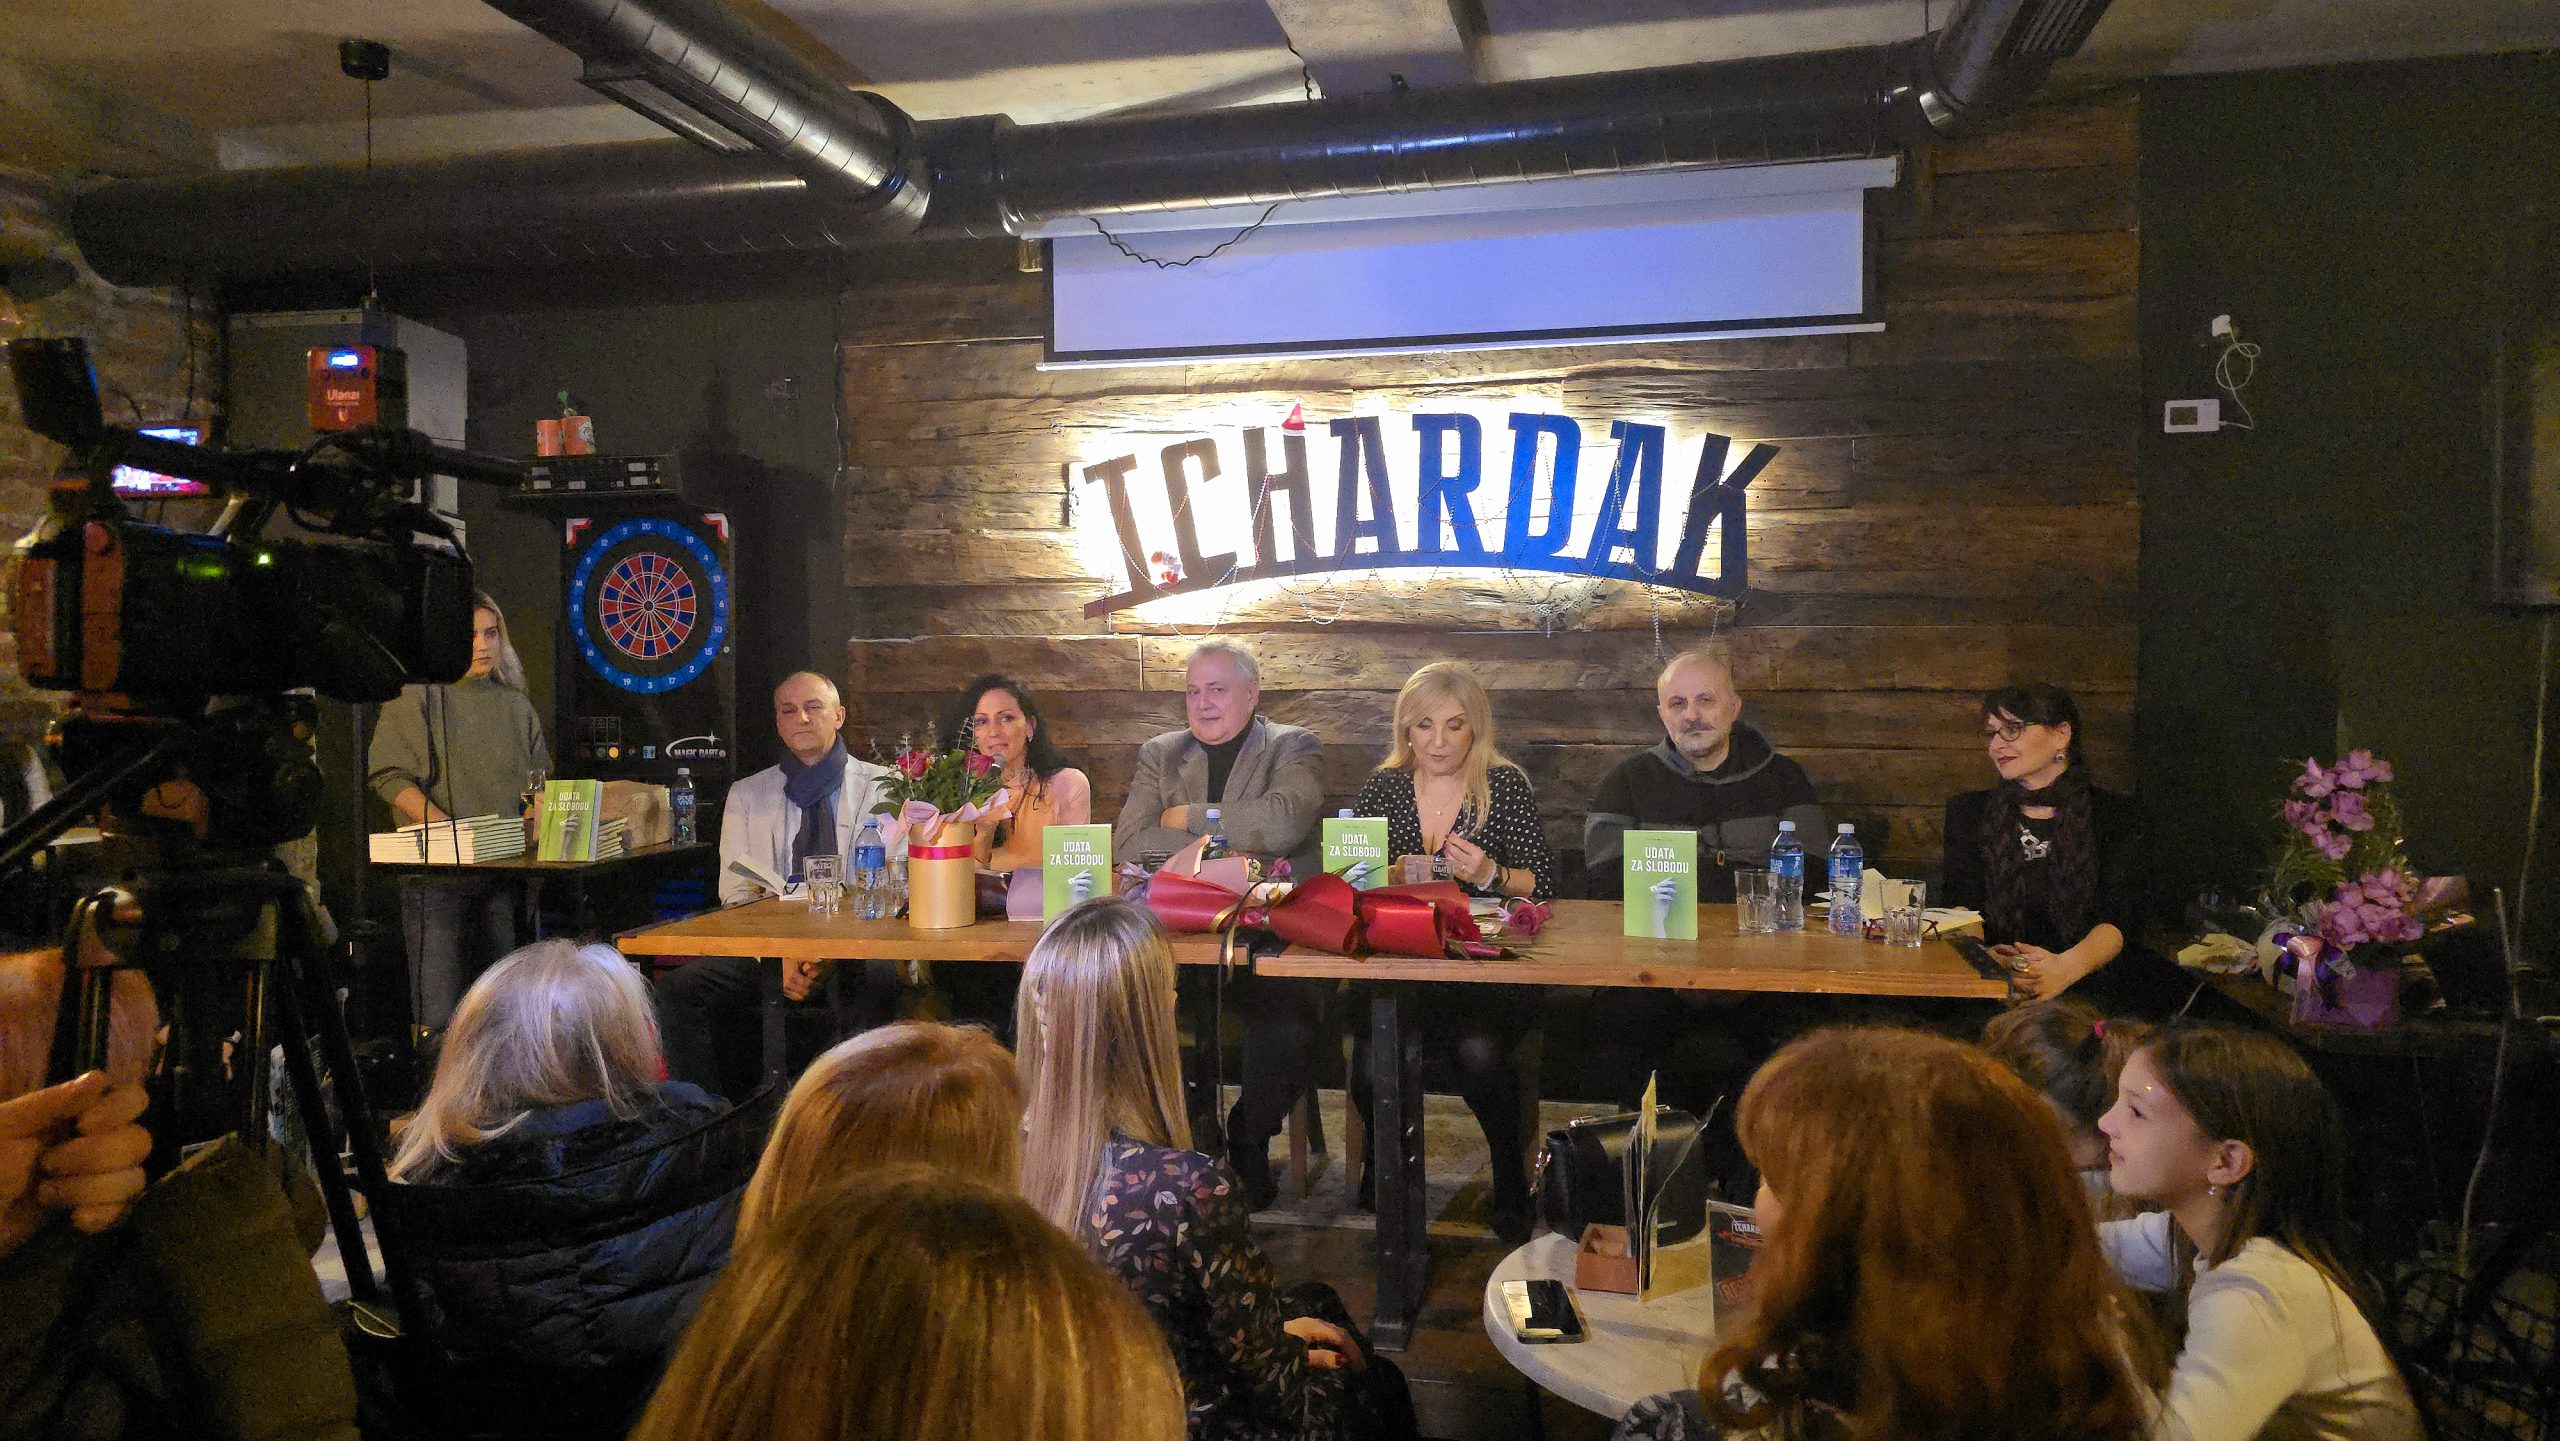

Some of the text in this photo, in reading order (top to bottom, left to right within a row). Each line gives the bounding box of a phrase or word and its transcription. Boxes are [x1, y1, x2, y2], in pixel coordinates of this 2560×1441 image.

[1085, 411, 1781, 606] TCHARDAK
[622, 527, 628, 535] 5
[641, 523, 651, 531] 20
[601, 539, 609, 547] 12
[719, 600, 725, 608] 6
[715, 626, 723, 634] 10
[704, 648, 713, 656] 15
[623, 678, 631, 686] 19
[668, 677, 676, 685] 17
[699, 748, 719, 758] DART
[559, 791, 581, 801] UDATA
[548, 801, 590, 811] ZA SLOBODU
[1342, 833, 1369, 845] UDATA
[1063, 841, 1091, 852] UDATA
[1329, 845, 1381, 857] ZA SLOBODU
[1645, 846, 1675, 860] UDATA
[1050, 854, 1104, 866] ZA SLOBODU
[1631, 859, 1689, 874] ZA SLOBODU
